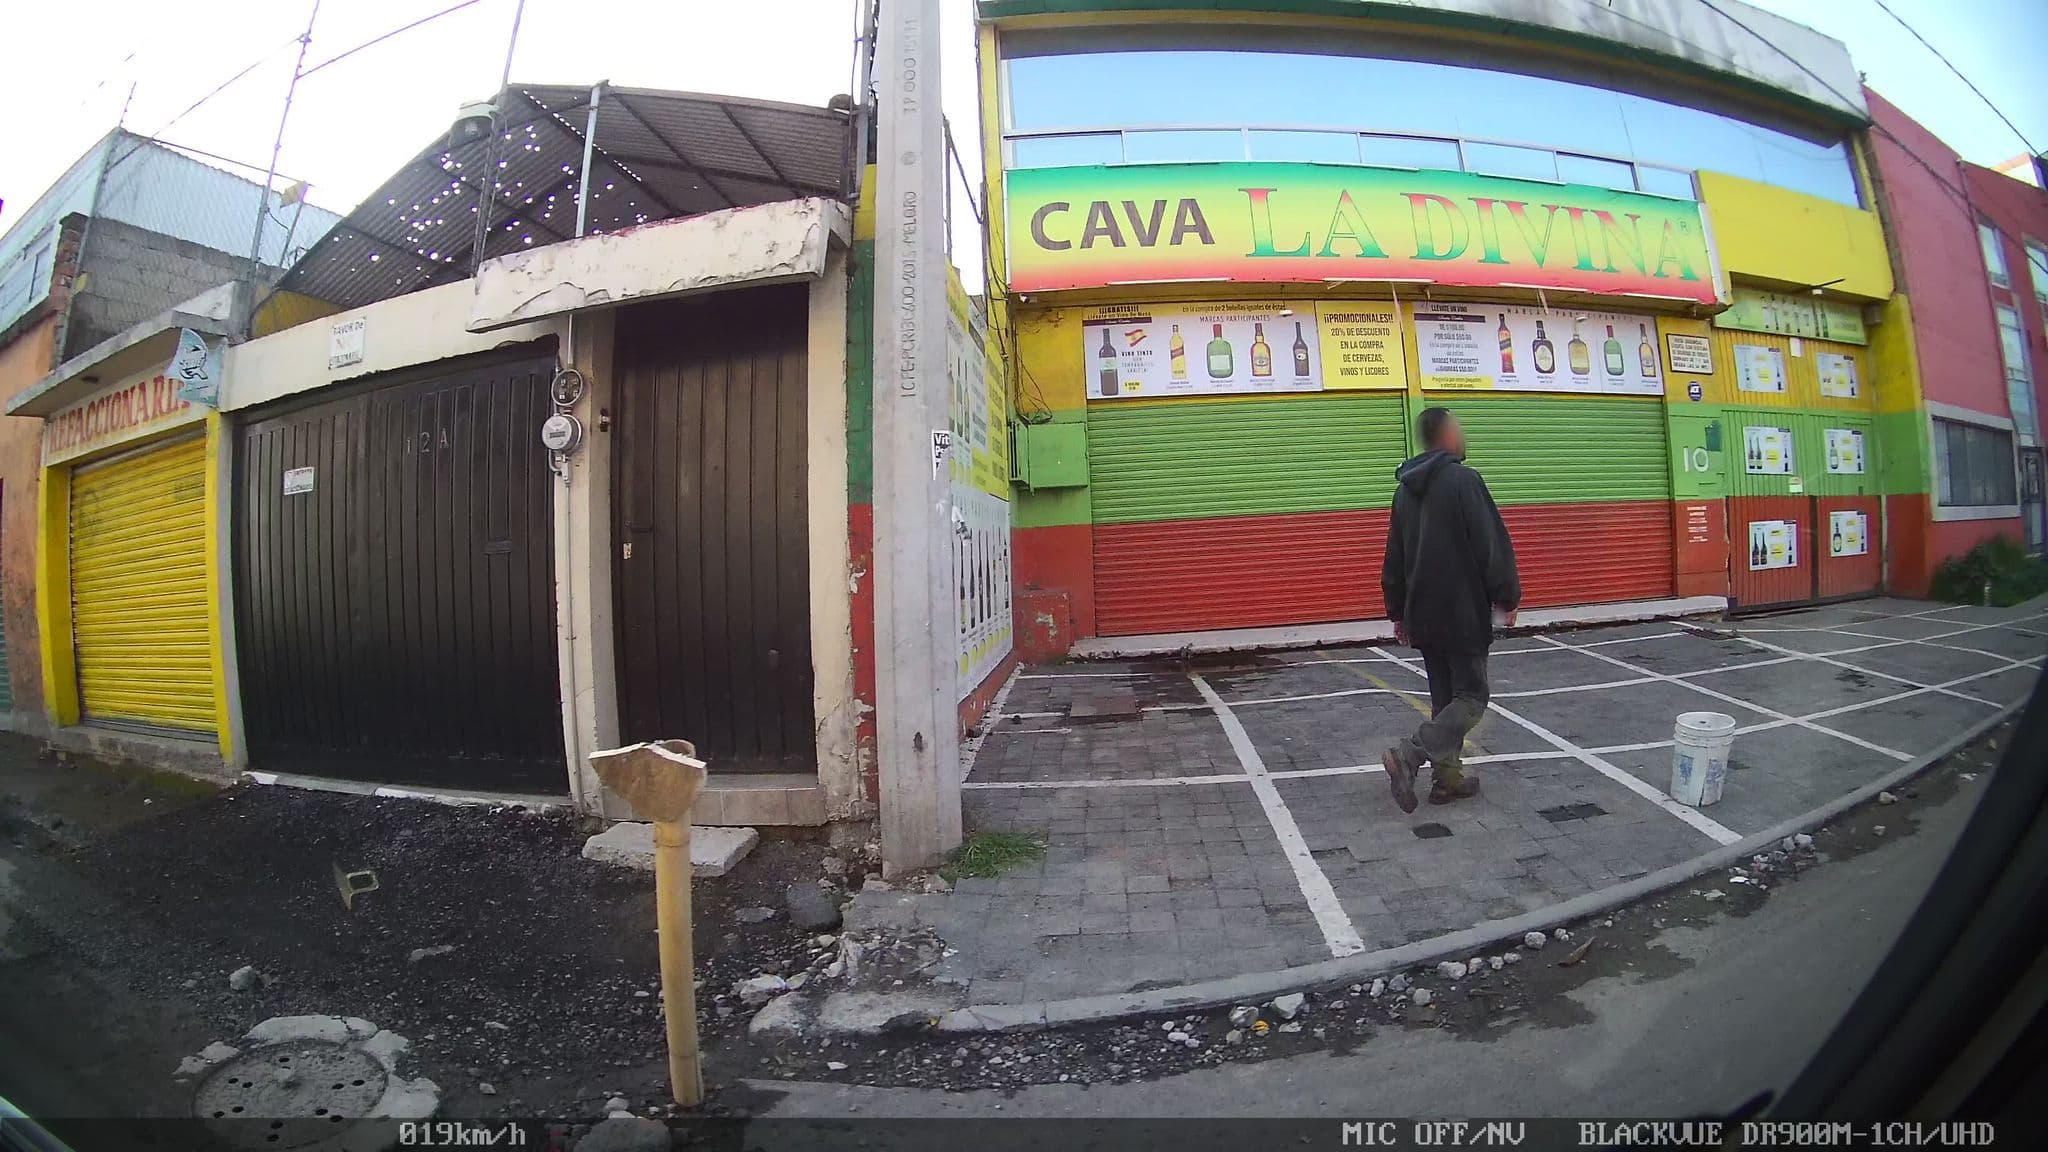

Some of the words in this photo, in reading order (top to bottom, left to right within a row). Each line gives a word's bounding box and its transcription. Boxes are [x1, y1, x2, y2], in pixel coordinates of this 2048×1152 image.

[1030, 198, 1216, 250] CAVA
[1238, 188, 1389, 258] LA
[1400, 192, 1698, 281] DIVINA
[1331, 328, 1345, 336] 20%
[1346, 328, 1354, 336] DE
[1356, 328, 1390, 336] DESCUENTO
[1340, 341, 1349, 349] EN
[1350, 341, 1358, 349] LA
[1359, 341, 1384, 349] COMPRA
[1343, 354, 1351, 362] DE
[1352, 354, 1385, 363] CERVEZAS,
[1340, 367, 1358, 376] VINOS
[1360, 367, 1365, 376] Y
[1365, 367, 1389, 376] LICORES
[1683, 446, 1709, 472] 10
